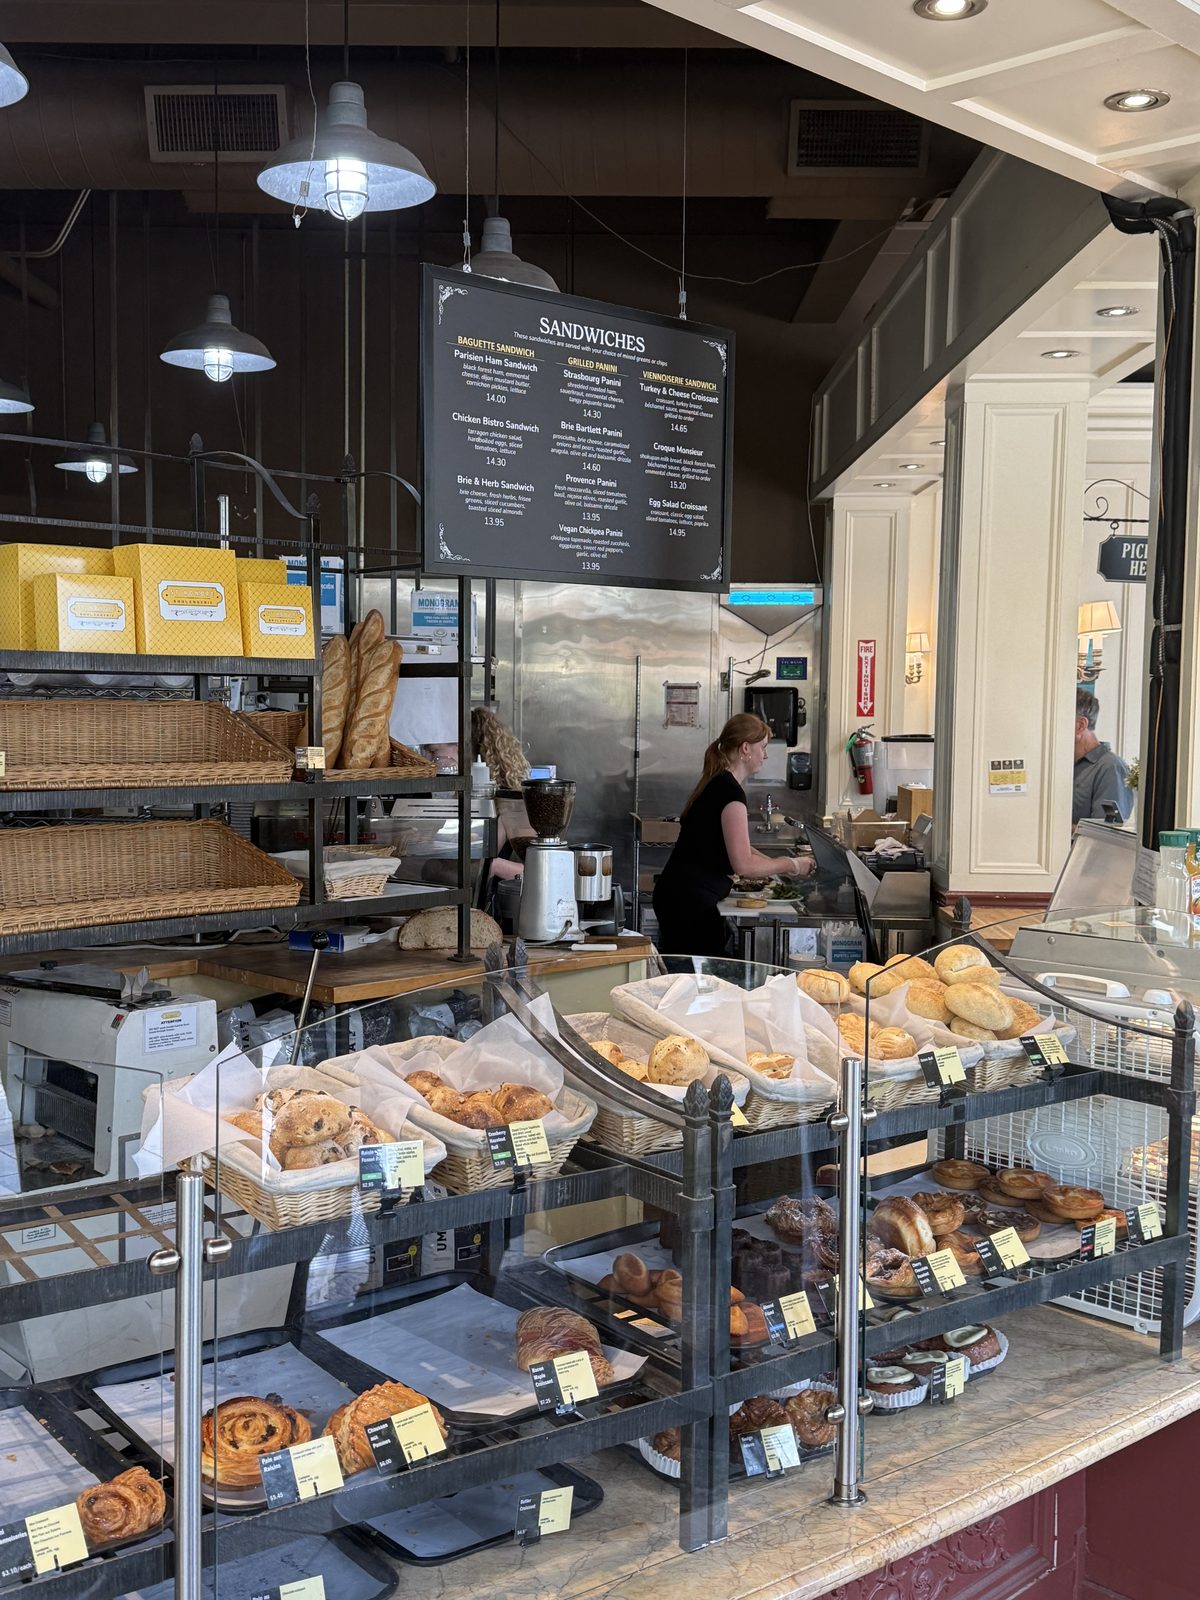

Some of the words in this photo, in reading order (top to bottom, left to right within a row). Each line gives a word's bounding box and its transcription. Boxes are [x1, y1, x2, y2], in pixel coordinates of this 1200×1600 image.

[539, 316, 645, 353] SANDWICHES
[457, 335, 495, 350] BAGUETTE
[496, 343, 534, 357] SANDWICH
[513, 331, 528, 340] These
[528, 335, 556, 345] sandwiches
[564, 342, 580, 350] served
[580, 344, 591, 352] with
[602, 349, 616, 357] choice
[656, 359, 667, 367] chips
[454, 349, 483, 362] Parisien
[485, 355, 502, 365] Ham
[503, 358, 537, 372] Sandwich
[567, 356, 594, 368] GRILLED
[595, 361, 617, 372] PANINI
[563, 369, 600, 384] Strasbourg
[601, 375, 621, 387] Panini
[642, 370, 683, 385] VIENNOISERIE
[684, 377, 716, 390] SANDWICH
[486, 392, 506, 404] 14.00
[639, 382, 661, 394] Turkey
[661, 386, 667, 395] &
[668, 387, 690, 399] Cheese
[690, 391, 718, 404] Croissant
[583, 408, 601, 419] 14.30
[452, 411, 481, 424] Chicken
[482, 416, 504, 427] Bistro
[505, 420, 539, 432] Sandwich
[671, 422, 687, 432] 14.65
[560, 420, 574, 430] Brie
[575, 423, 601, 434] Bartlett
[602, 427, 622, 437] Panini
[653, 442, 675, 452] Croque
[676, 445, 703, 456] Monsieur
[486, 456, 506, 466] 14.30
[582, 461, 600, 471] 14.60
[457, 474, 472, 484] Brie
[473, 476, 479, 485] &
[481, 478, 499, 487] Herb
[500, 480, 534, 492] Sandwich
[565, 474, 595, 485] Provence
[596, 477, 617, 487] Panini
[670, 480, 686, 490] 15.20
[648, 497, 661, 508] Egg
[661, 499, 679, 508] Salad
[680, 501, 707, 511] Croissant
[484, 516, 504, 526] 13.95
[582, 511, 600, 521] 13.95
[558, 524, 577, 534] Vegan
[578, 525, 604, 535] Chickpea
[605, 528, 623, 537] Panini
[669, 527, 685, 536] 14.95
[582, 561, 600, 570] 13.95
[1129, 561, 1147, 576] HE
[535, 1378, 554, 1387] Croissant
[372, 1438, 391, 1449] Pommes
[261, 1457, 273, 1465] Pain
[263, 1463, 282, 1472] Raisins
[519, 1503, 536, 1512] Croissant
[1, 1562, 33, 1577] $3.10/each
